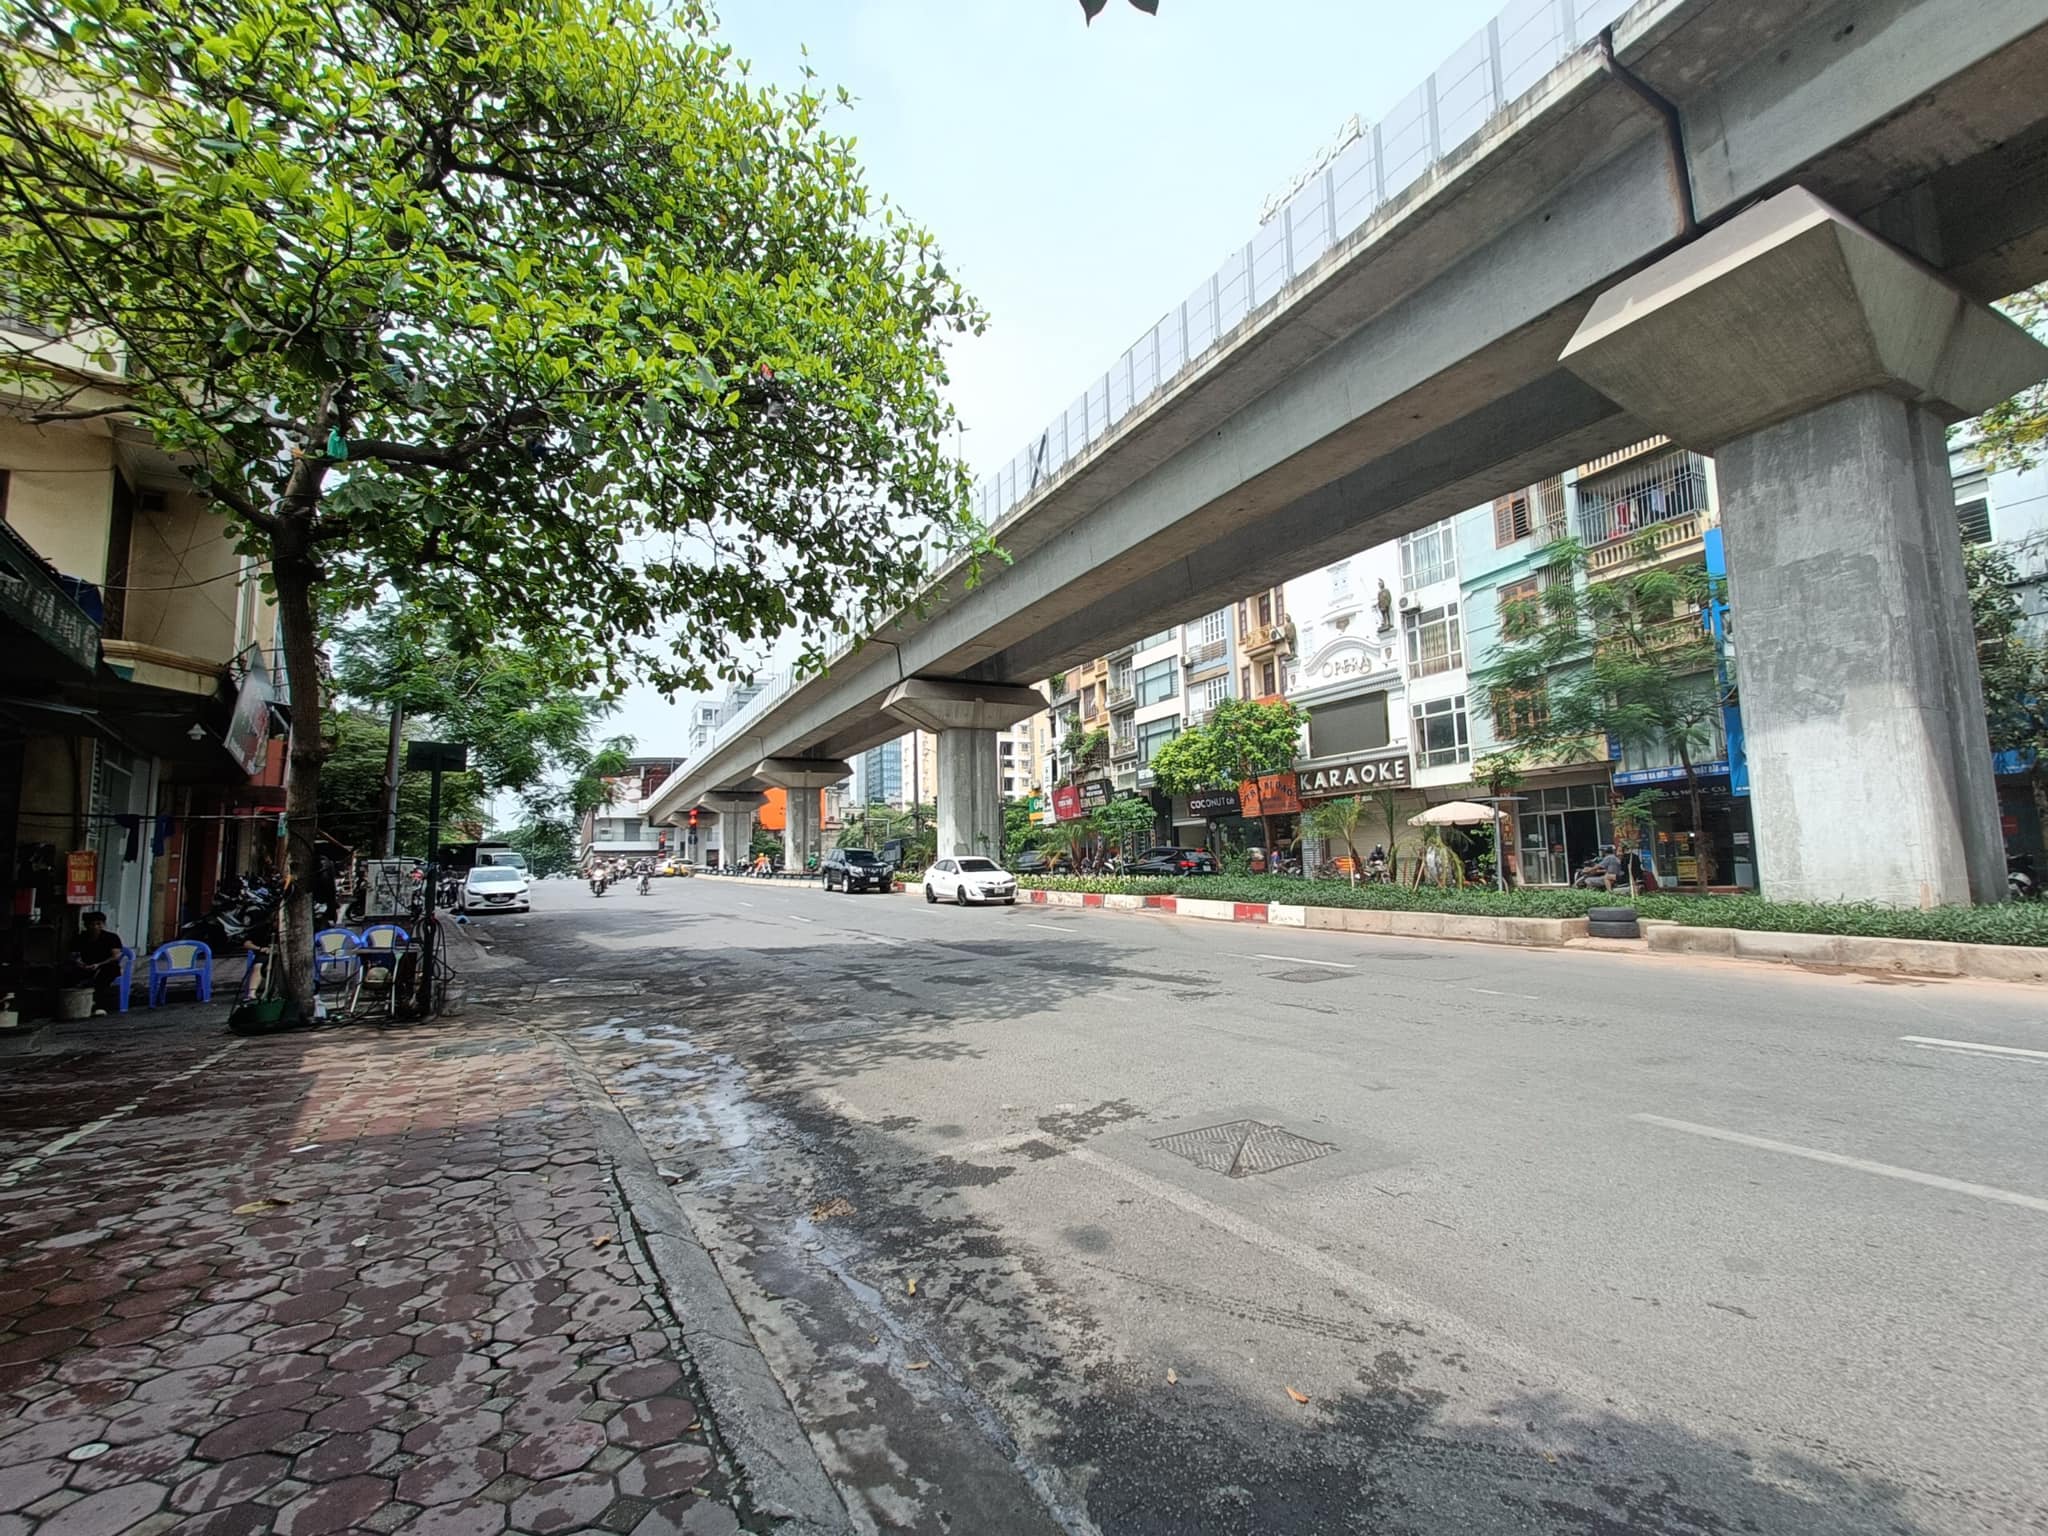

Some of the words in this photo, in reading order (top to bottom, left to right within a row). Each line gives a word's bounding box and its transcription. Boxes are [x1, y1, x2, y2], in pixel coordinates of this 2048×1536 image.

[1321, 655, 1372, 678] OPERA
[1299, 760, 1406, 791] KARAOKE
[1190, 796, 1226, 809] COCONUT
